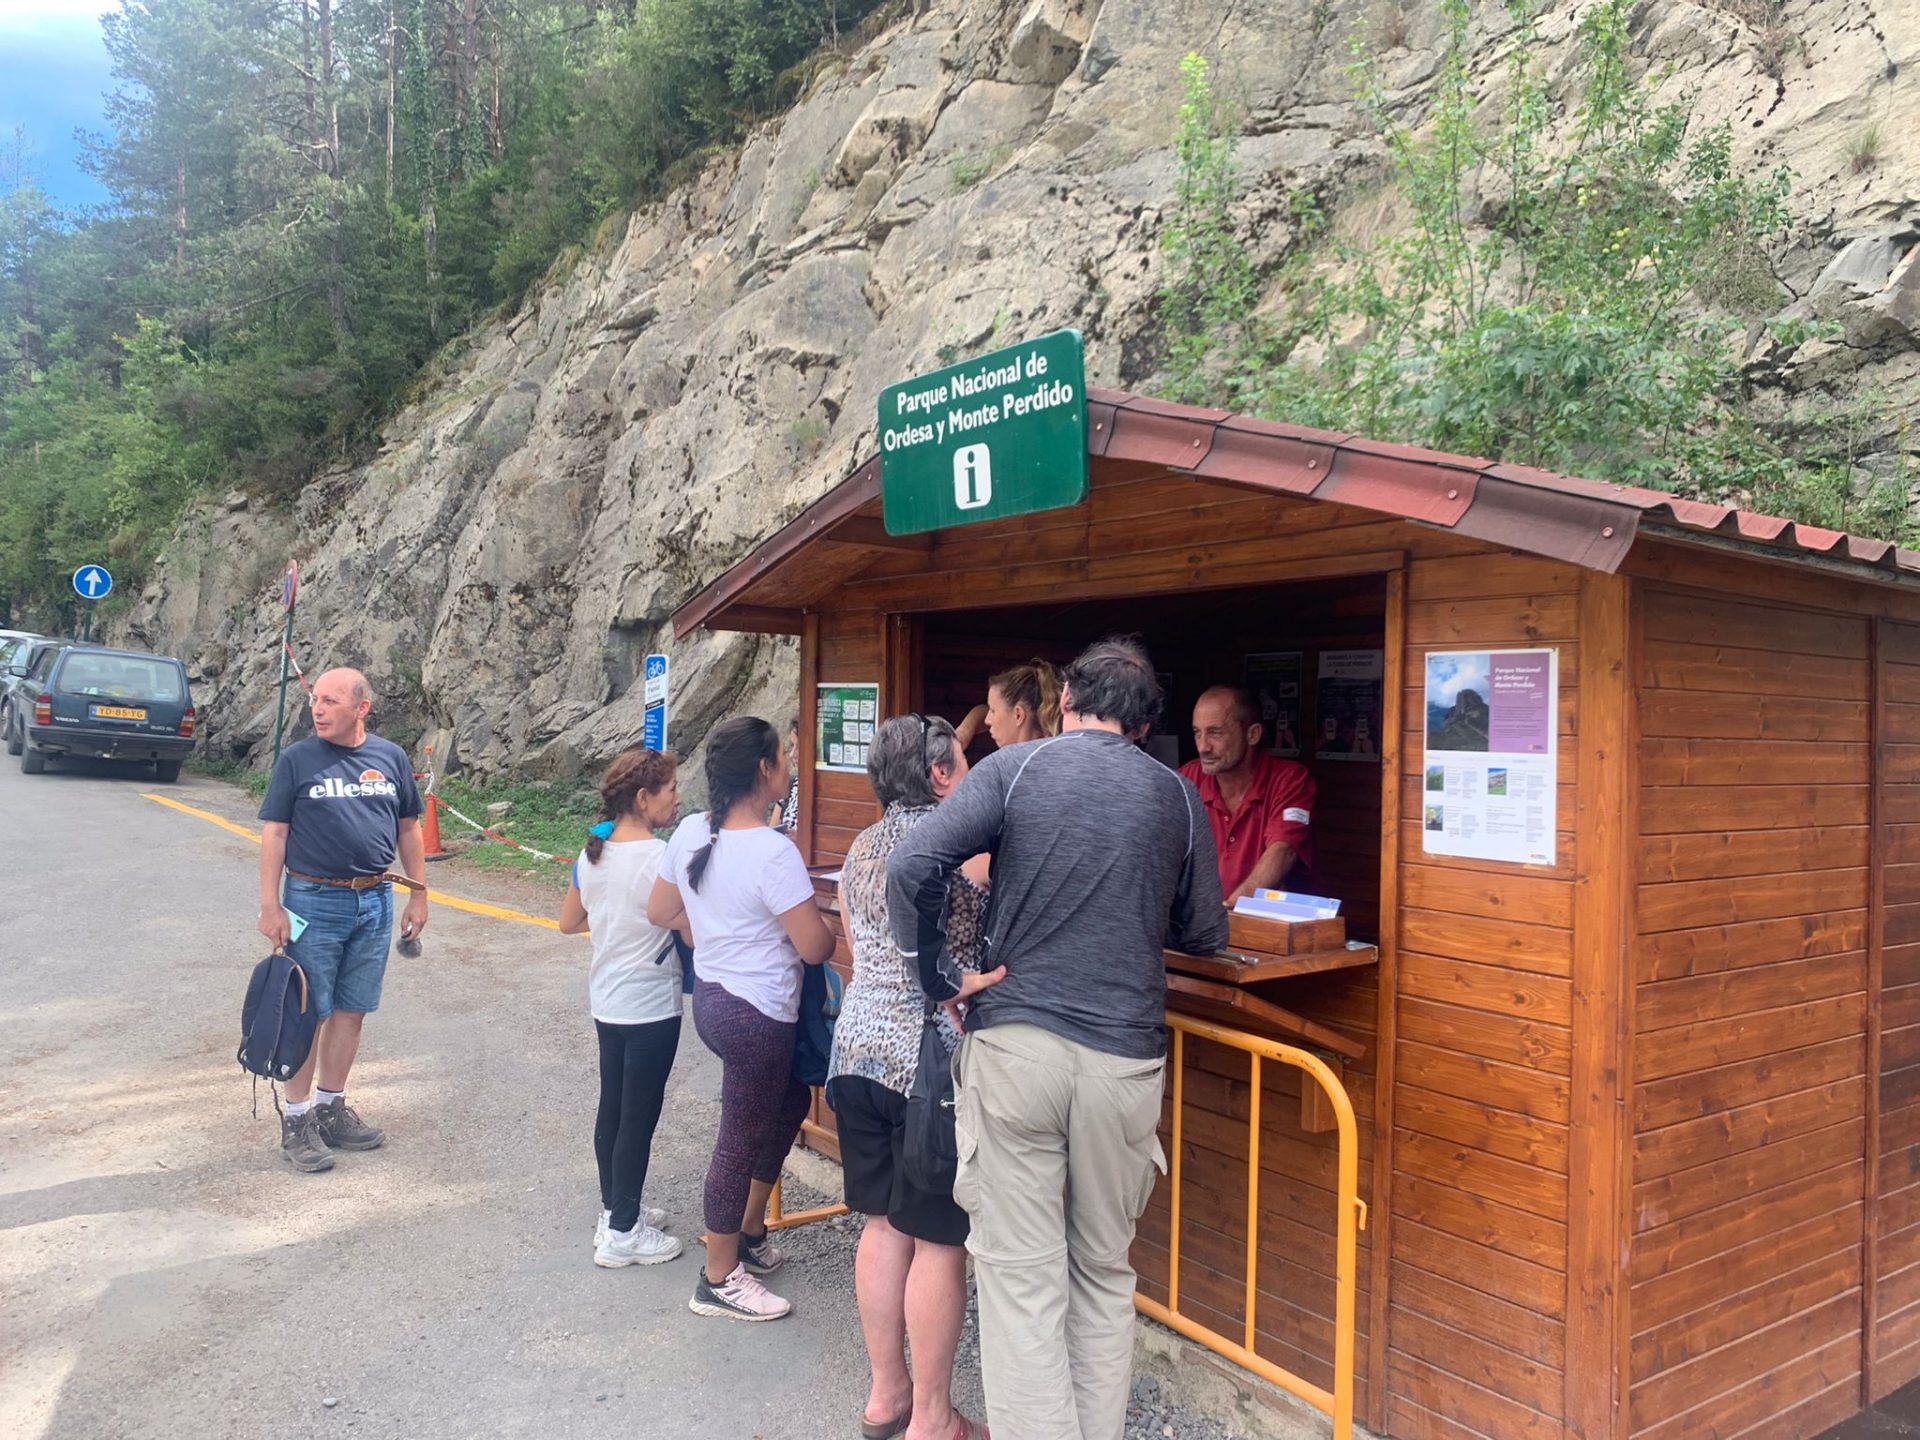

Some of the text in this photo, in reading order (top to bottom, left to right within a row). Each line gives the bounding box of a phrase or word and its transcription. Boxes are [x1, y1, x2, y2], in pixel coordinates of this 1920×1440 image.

[884, 379, 1073, 451] Ordesa y Monte Perdido
[897, 351, 1048, 415] Parque Nacional de
[309, 778, 397, 798] ellesse
